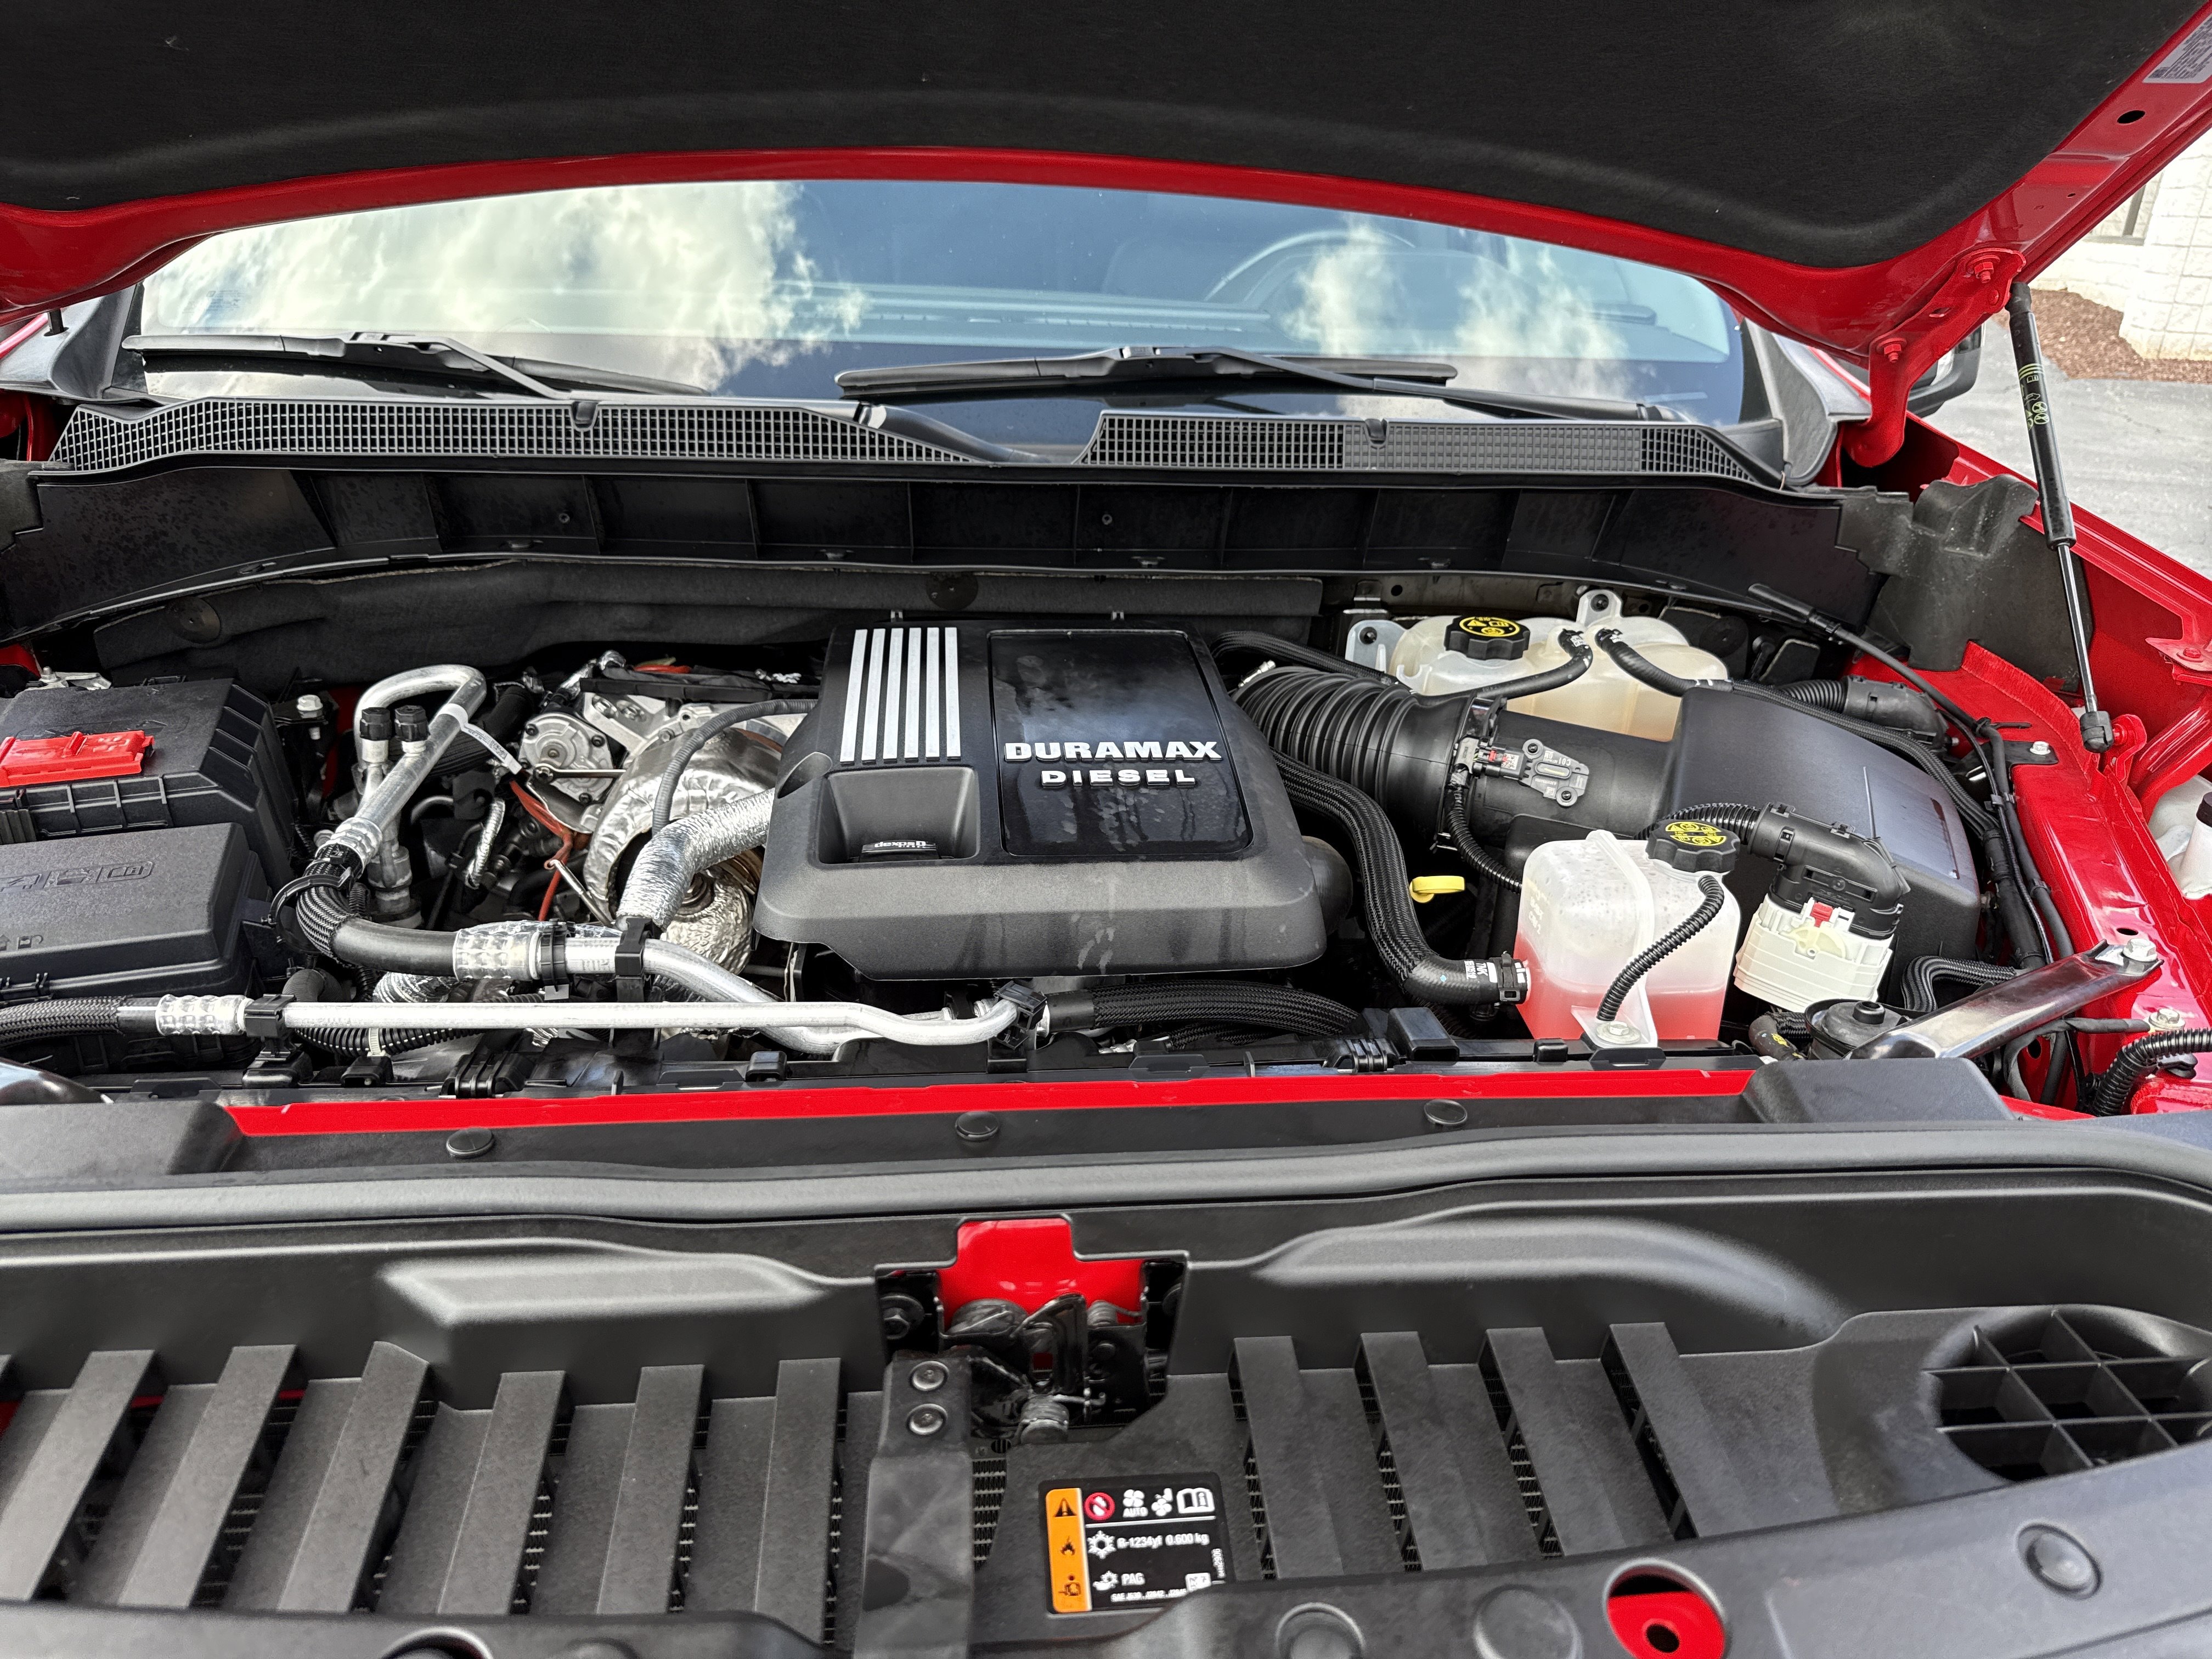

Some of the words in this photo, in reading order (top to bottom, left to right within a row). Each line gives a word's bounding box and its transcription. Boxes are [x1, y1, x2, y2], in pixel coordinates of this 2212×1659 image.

[1005, 742, 1222, 761] DURAMAX
[1041, 769, 1196, 786] DIESEL
[1123, 1507, 1148, 1517] AUTO
[1117, 1536, 1163, 1549] R-1234yf
[1165, 1533, 1194, 1546] 0.600
[1195, 1532, 1210, 1545] kg
[1121, 1573, 1145, 1586] PAG
